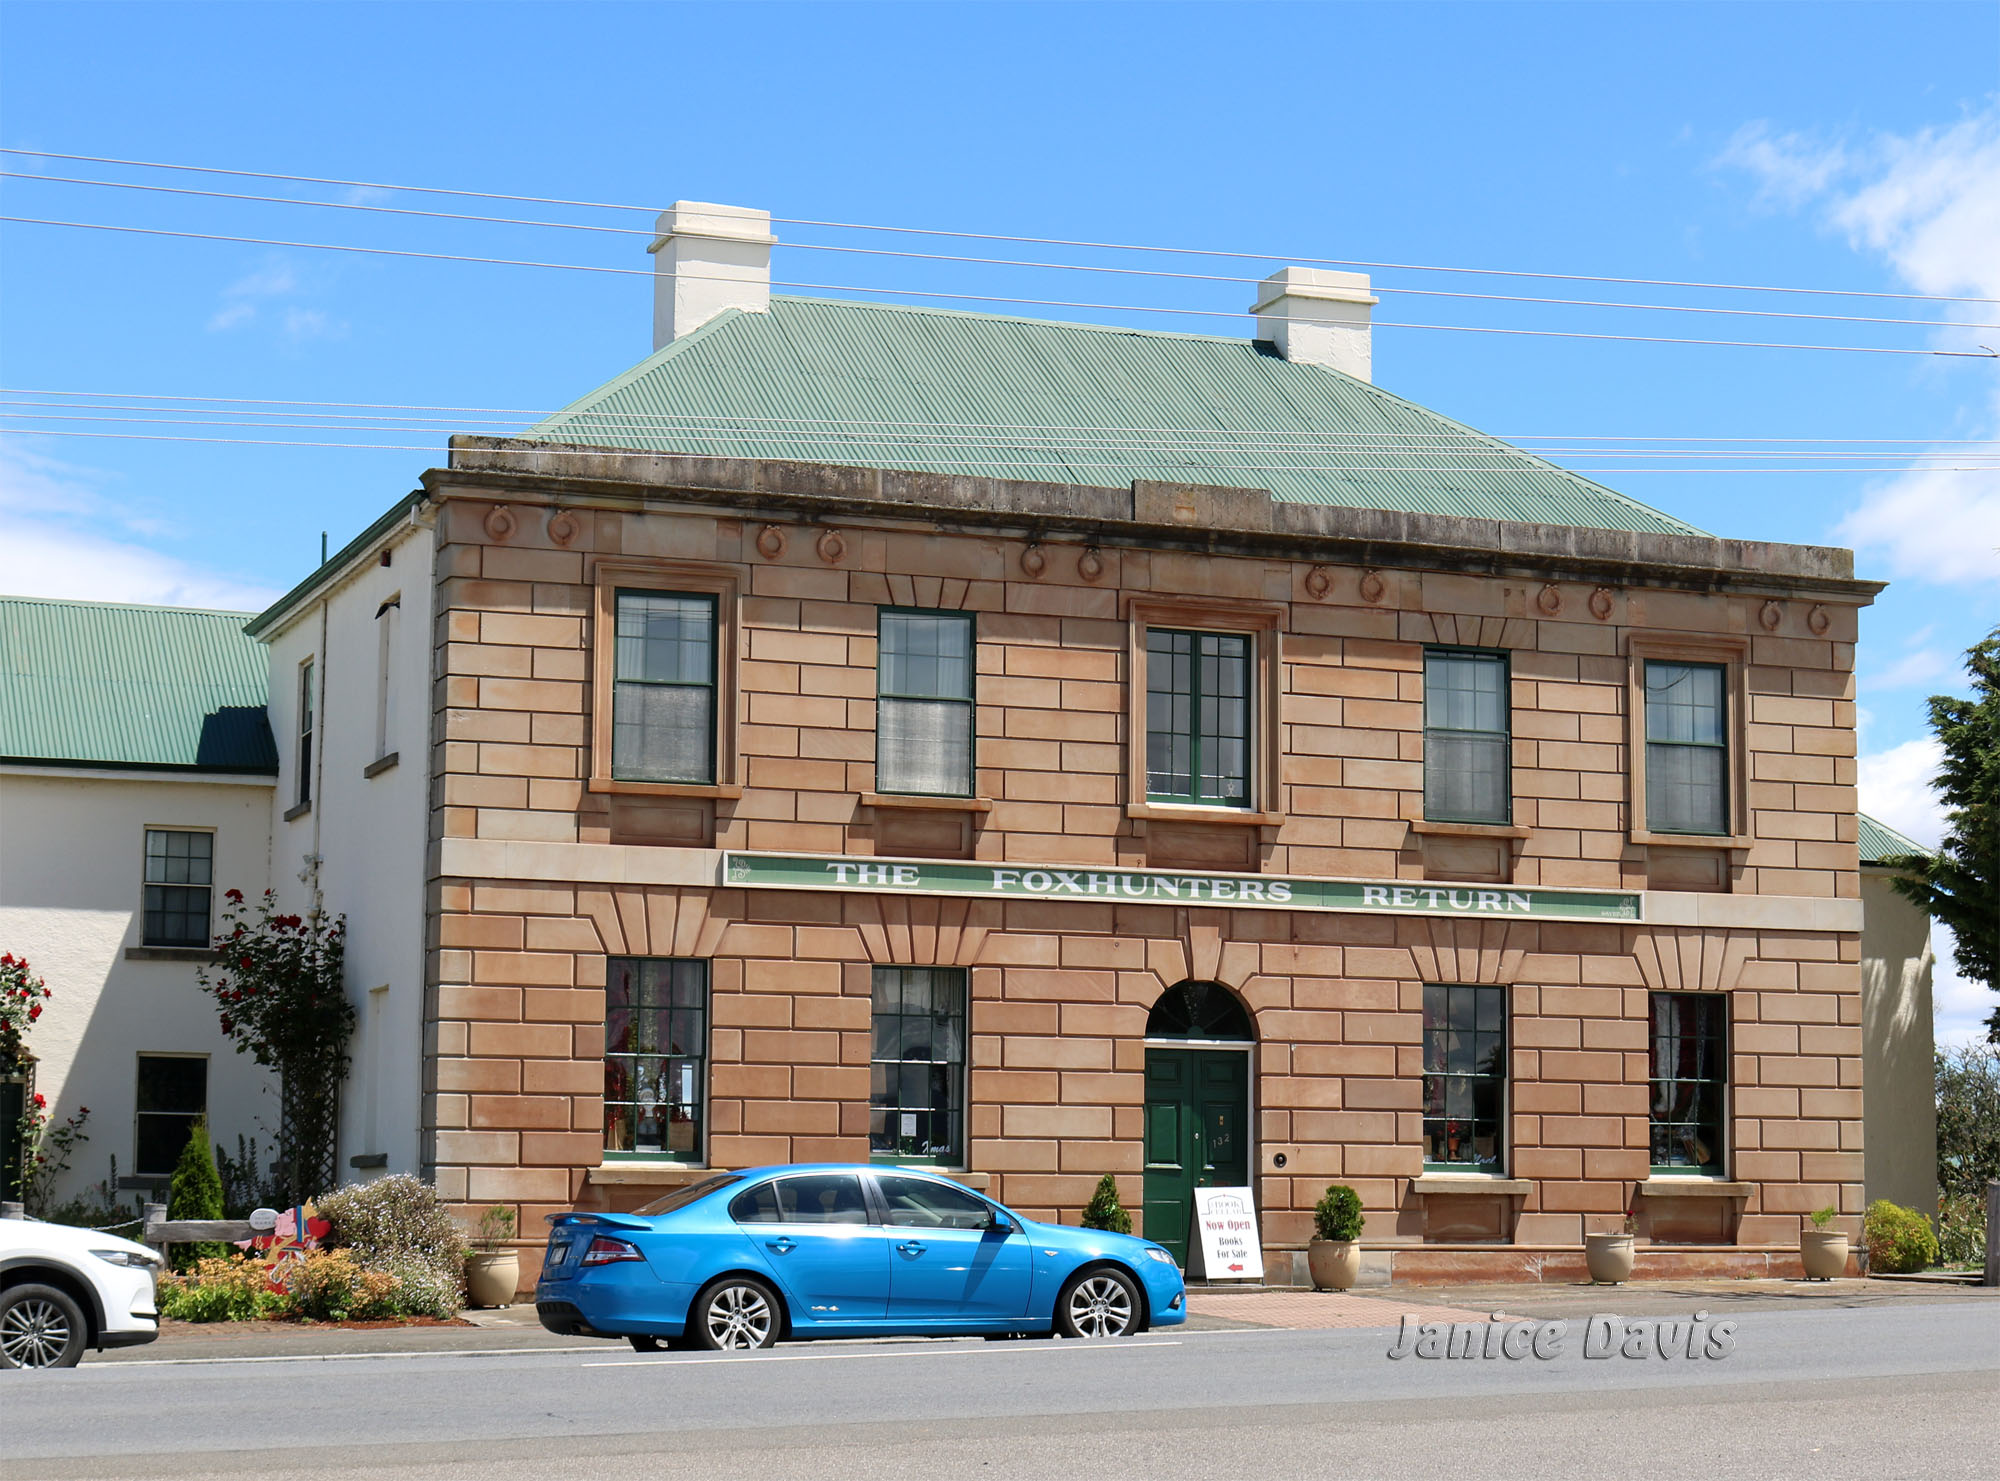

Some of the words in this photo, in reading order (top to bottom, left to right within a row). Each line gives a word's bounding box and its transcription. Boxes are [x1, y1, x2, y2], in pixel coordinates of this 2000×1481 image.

[826, 862, 921, 886] THE
[991, 869, 1293, 902] FOXHUNTERS
[1362, 886, 1533, 912] RETURN
[1213, 1133, 1230, 1149] 132
[1206, 1220, 1224, 1231] Now
[1227, 1219, 1251, 1231] Open
[1218, 1236, 1243, 1246] Books
[1217, 1249, 1230, 1259] For
[1231, 1249, 1248, 1259] Sale
